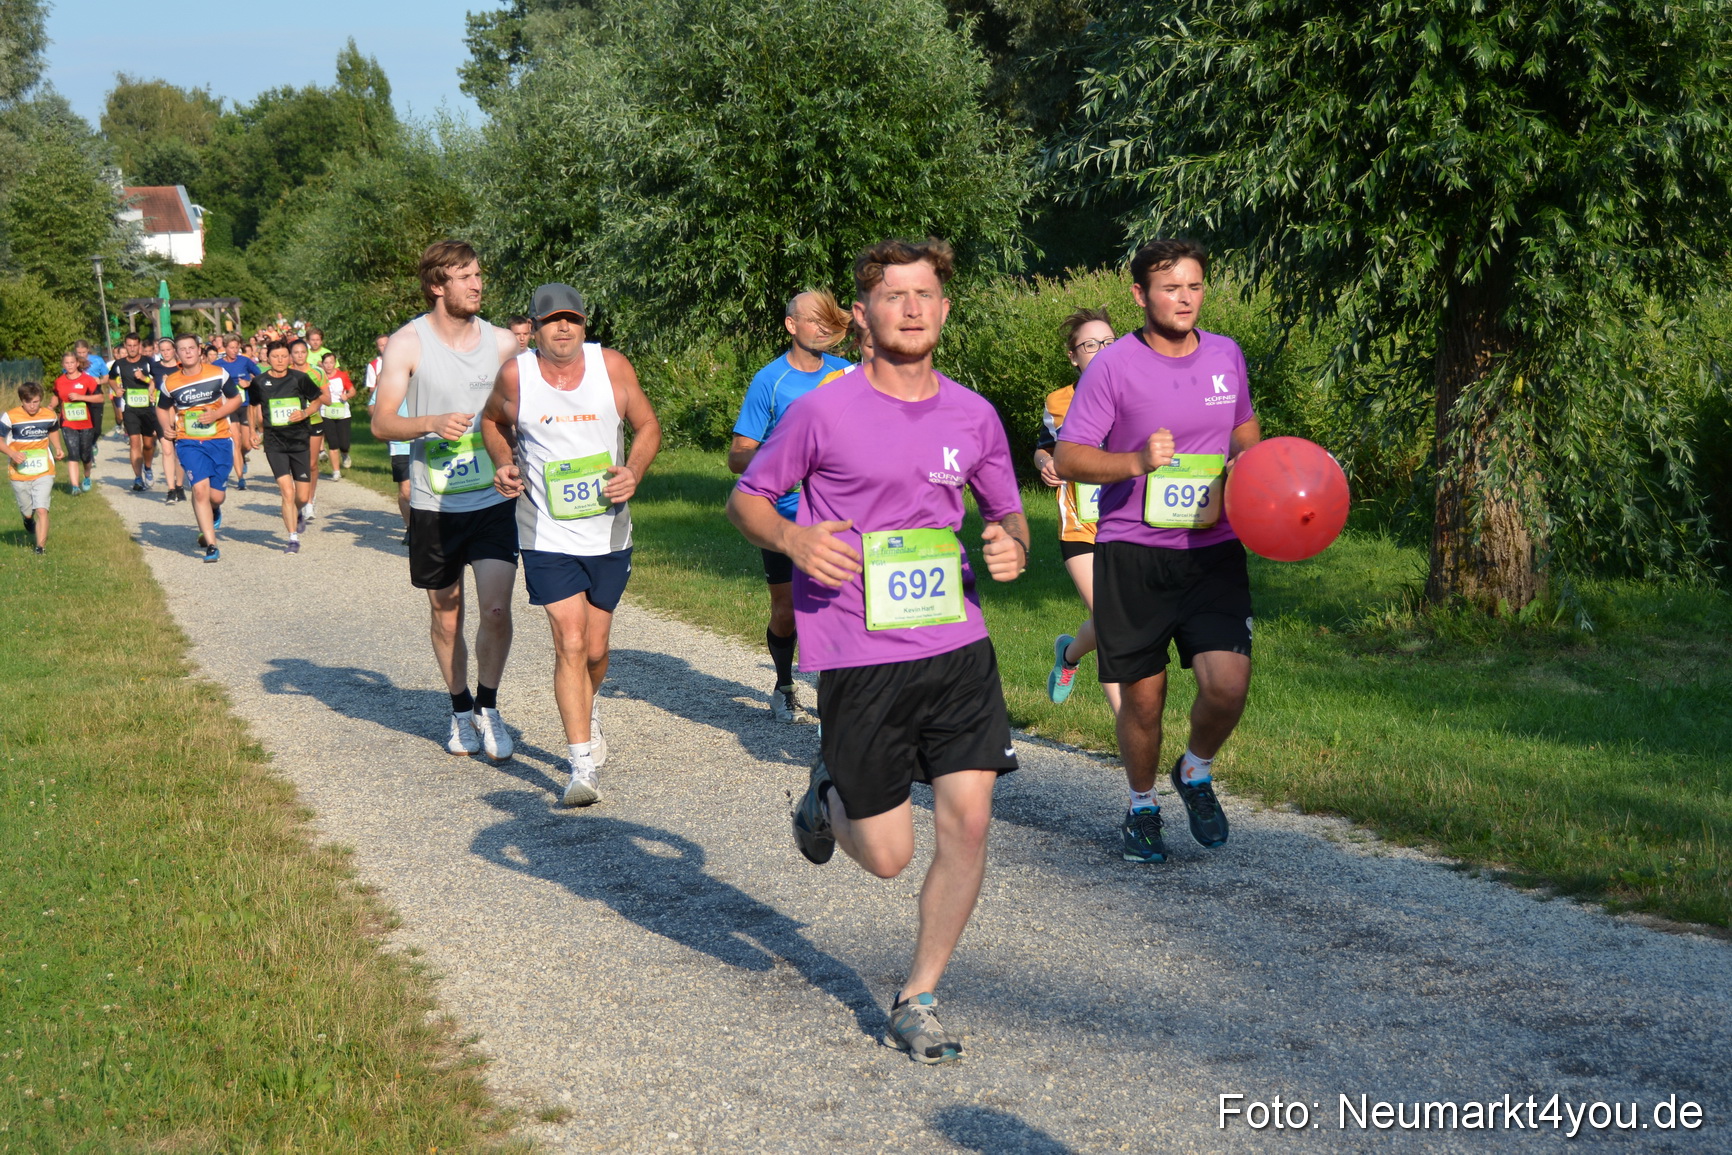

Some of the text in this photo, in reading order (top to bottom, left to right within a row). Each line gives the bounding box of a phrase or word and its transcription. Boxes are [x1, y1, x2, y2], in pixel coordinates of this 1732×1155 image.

[129, 395, 147, 404] 1093
[185, 390, 214, 401] Fischer
[1204, 394, 1237, 403] KÜFNER
[67, 409, 85, 417] 1168
[556, 414, 601, 422] KLEBL
[25, 429, 48, 437] Fischer
[442, 456, 480, 479] 351
[563, 478, 602, 503] 581
[1164, 484, 1210, 508] 693
[888, 567, 946, 602] 692
